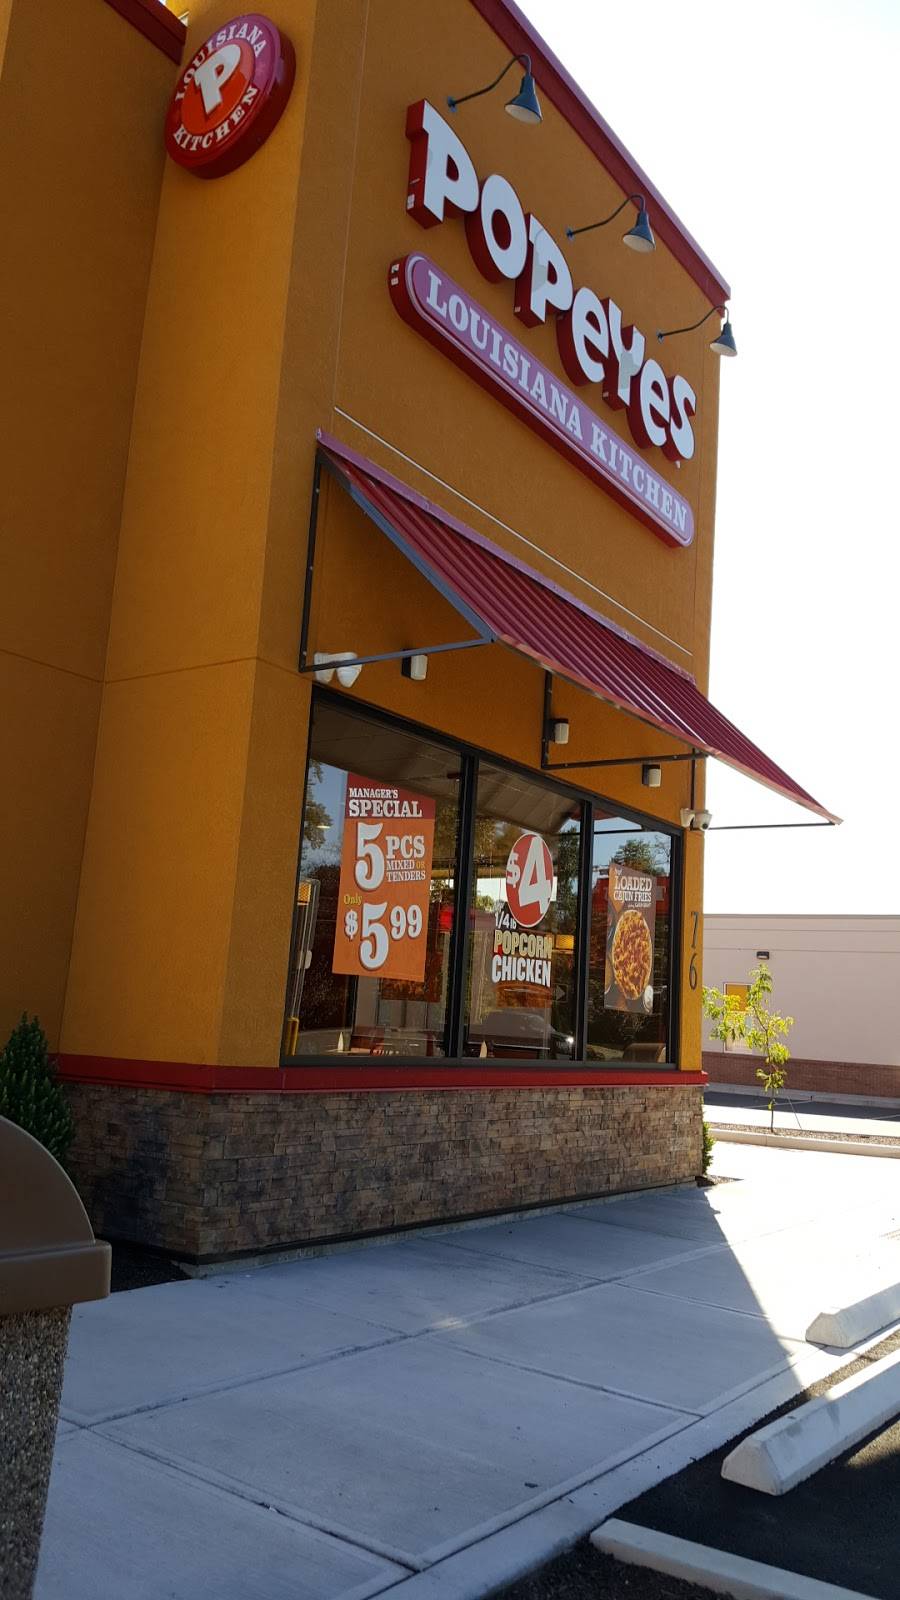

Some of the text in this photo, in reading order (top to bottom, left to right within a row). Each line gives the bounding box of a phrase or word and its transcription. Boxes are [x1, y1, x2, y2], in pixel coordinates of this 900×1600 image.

[175, 22, 267, 101] LOUISIANA
[194, 44, 241, 114] P
[173, 84, 258, 151] KITCHEN
[425, 268, 688, 534] LOUISIANA KITCHEN
[349, 787, 399, 799] MANAGER'S
[348, 799, 422, 818] SPECIAL
[355, 822, 425, 889] 5 PCS
[386, 860, 415, 870] MIXED
[386, 870, 426, 882] TENDERS
[614, 875, 653, 892] LOADED
[343, 893, 363, 905] Only
[634, 891, 652, 902] FRIES
[494, 929, 553, 960] POPCORN
[491, 954, 552, 988] CHICKEN
